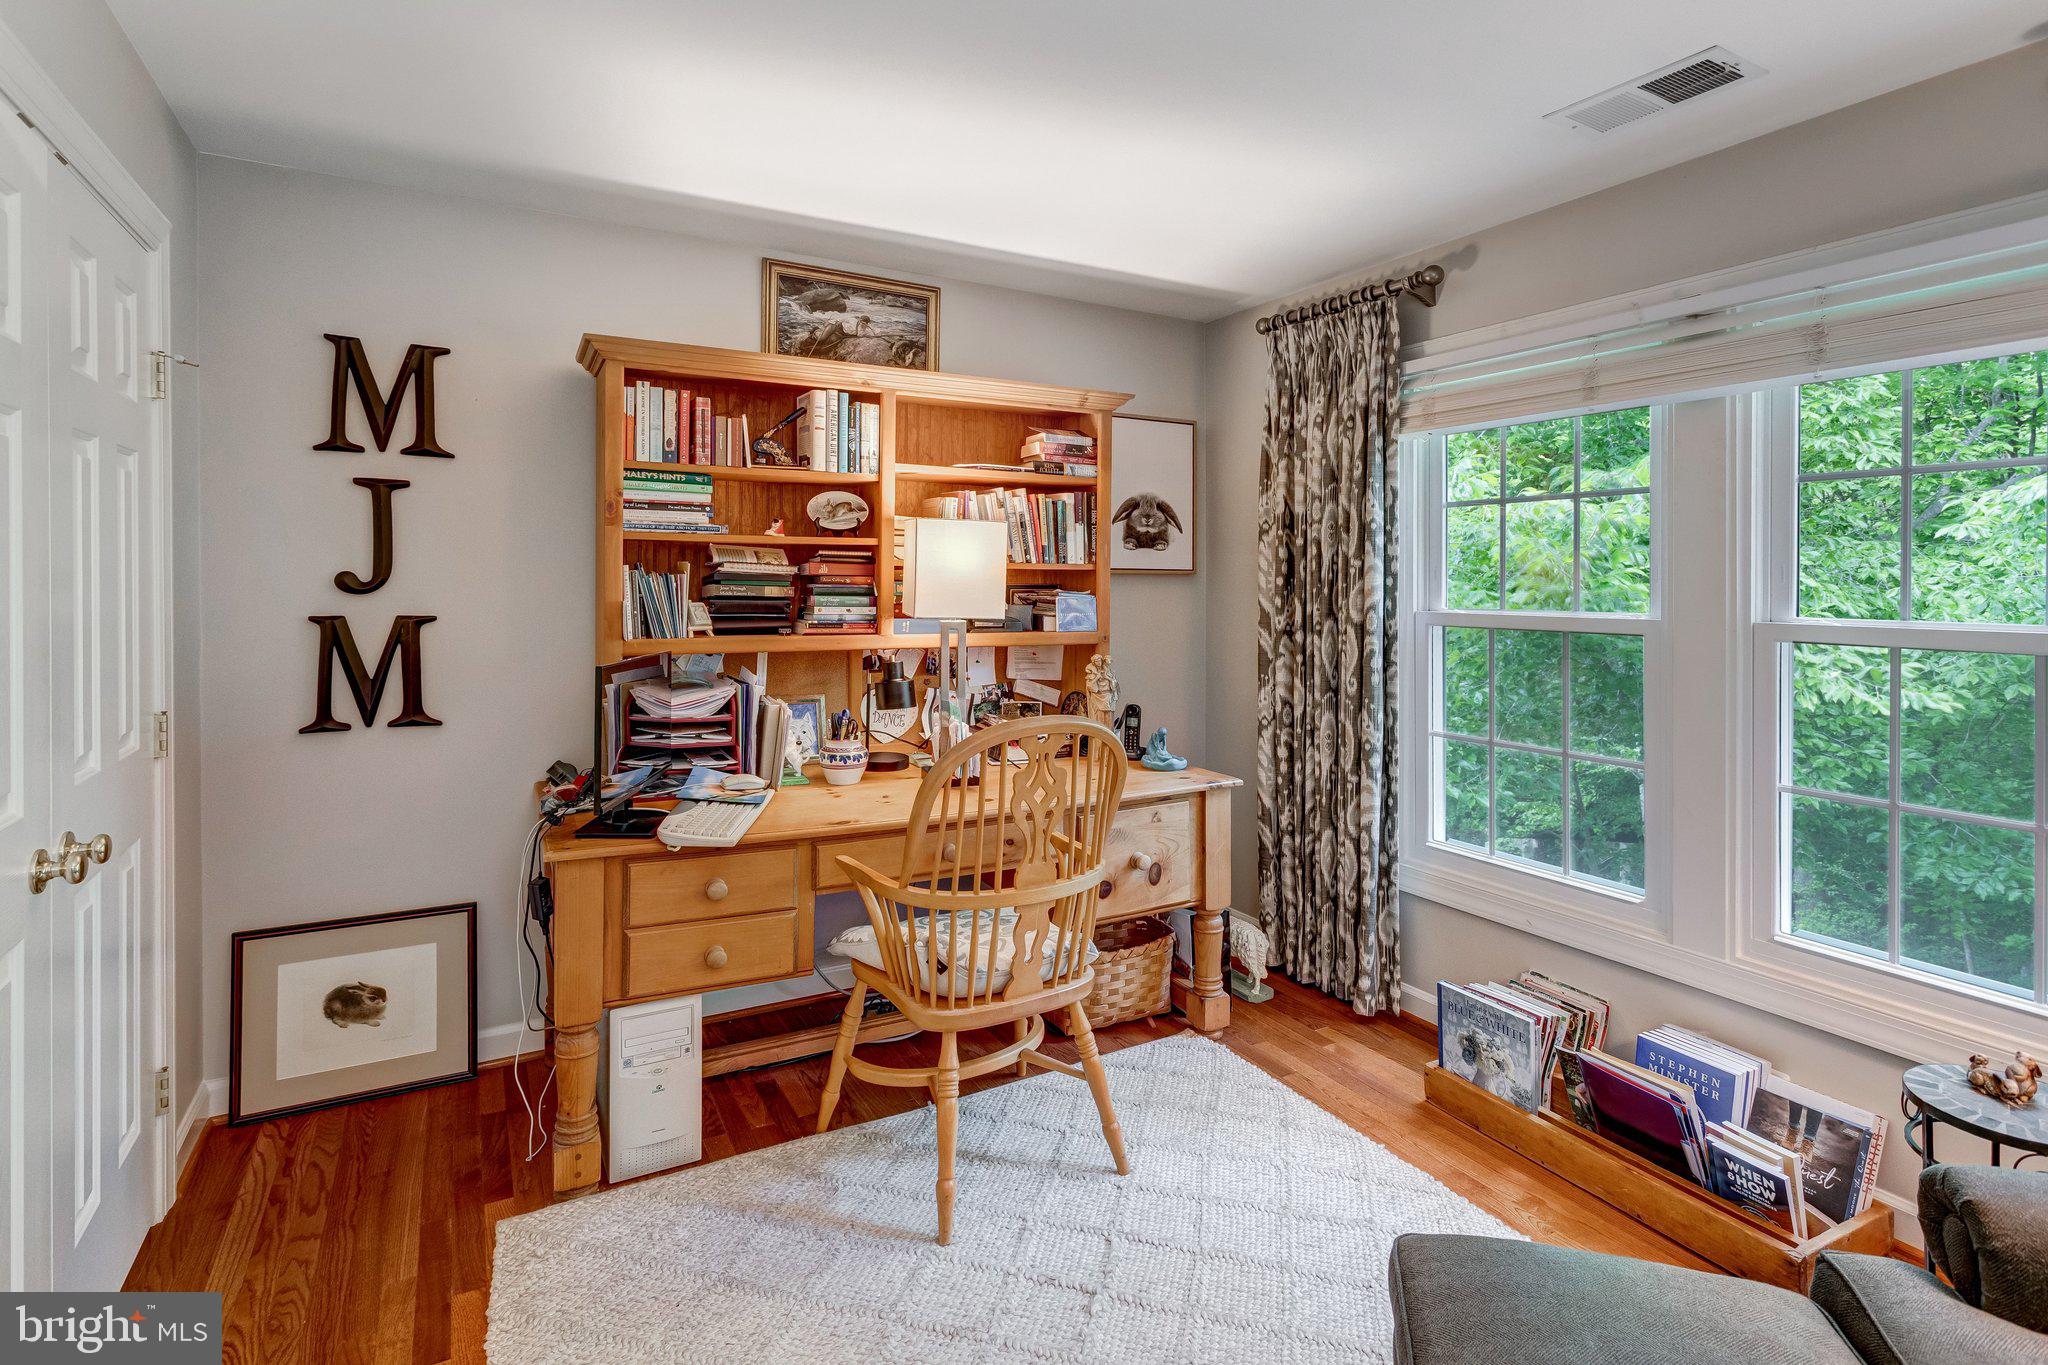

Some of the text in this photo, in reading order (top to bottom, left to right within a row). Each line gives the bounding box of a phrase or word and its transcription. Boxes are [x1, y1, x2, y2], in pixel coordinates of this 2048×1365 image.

[313, 333, 455, 458] M
[624, 470, 658, 479] HALEY'S
[333, 477, 411, 594] J
[299, 614, 444, 734] M
[873, 711, 906, 728] DANCE
[1448, 1000, 1475, 1020] BLUE
[1486, 1017, 1526, 1043] WHITE
[1648, 1062, 1720, 1101] MINISTER
[1650, 1052, 1720, 1088] STEPHEN
[1724, 1157, 1776, 1191] WHEN
[1862, 1133, 1879, 1192] COUNTER
[1736, 1174, 1776, 1201] HOW
